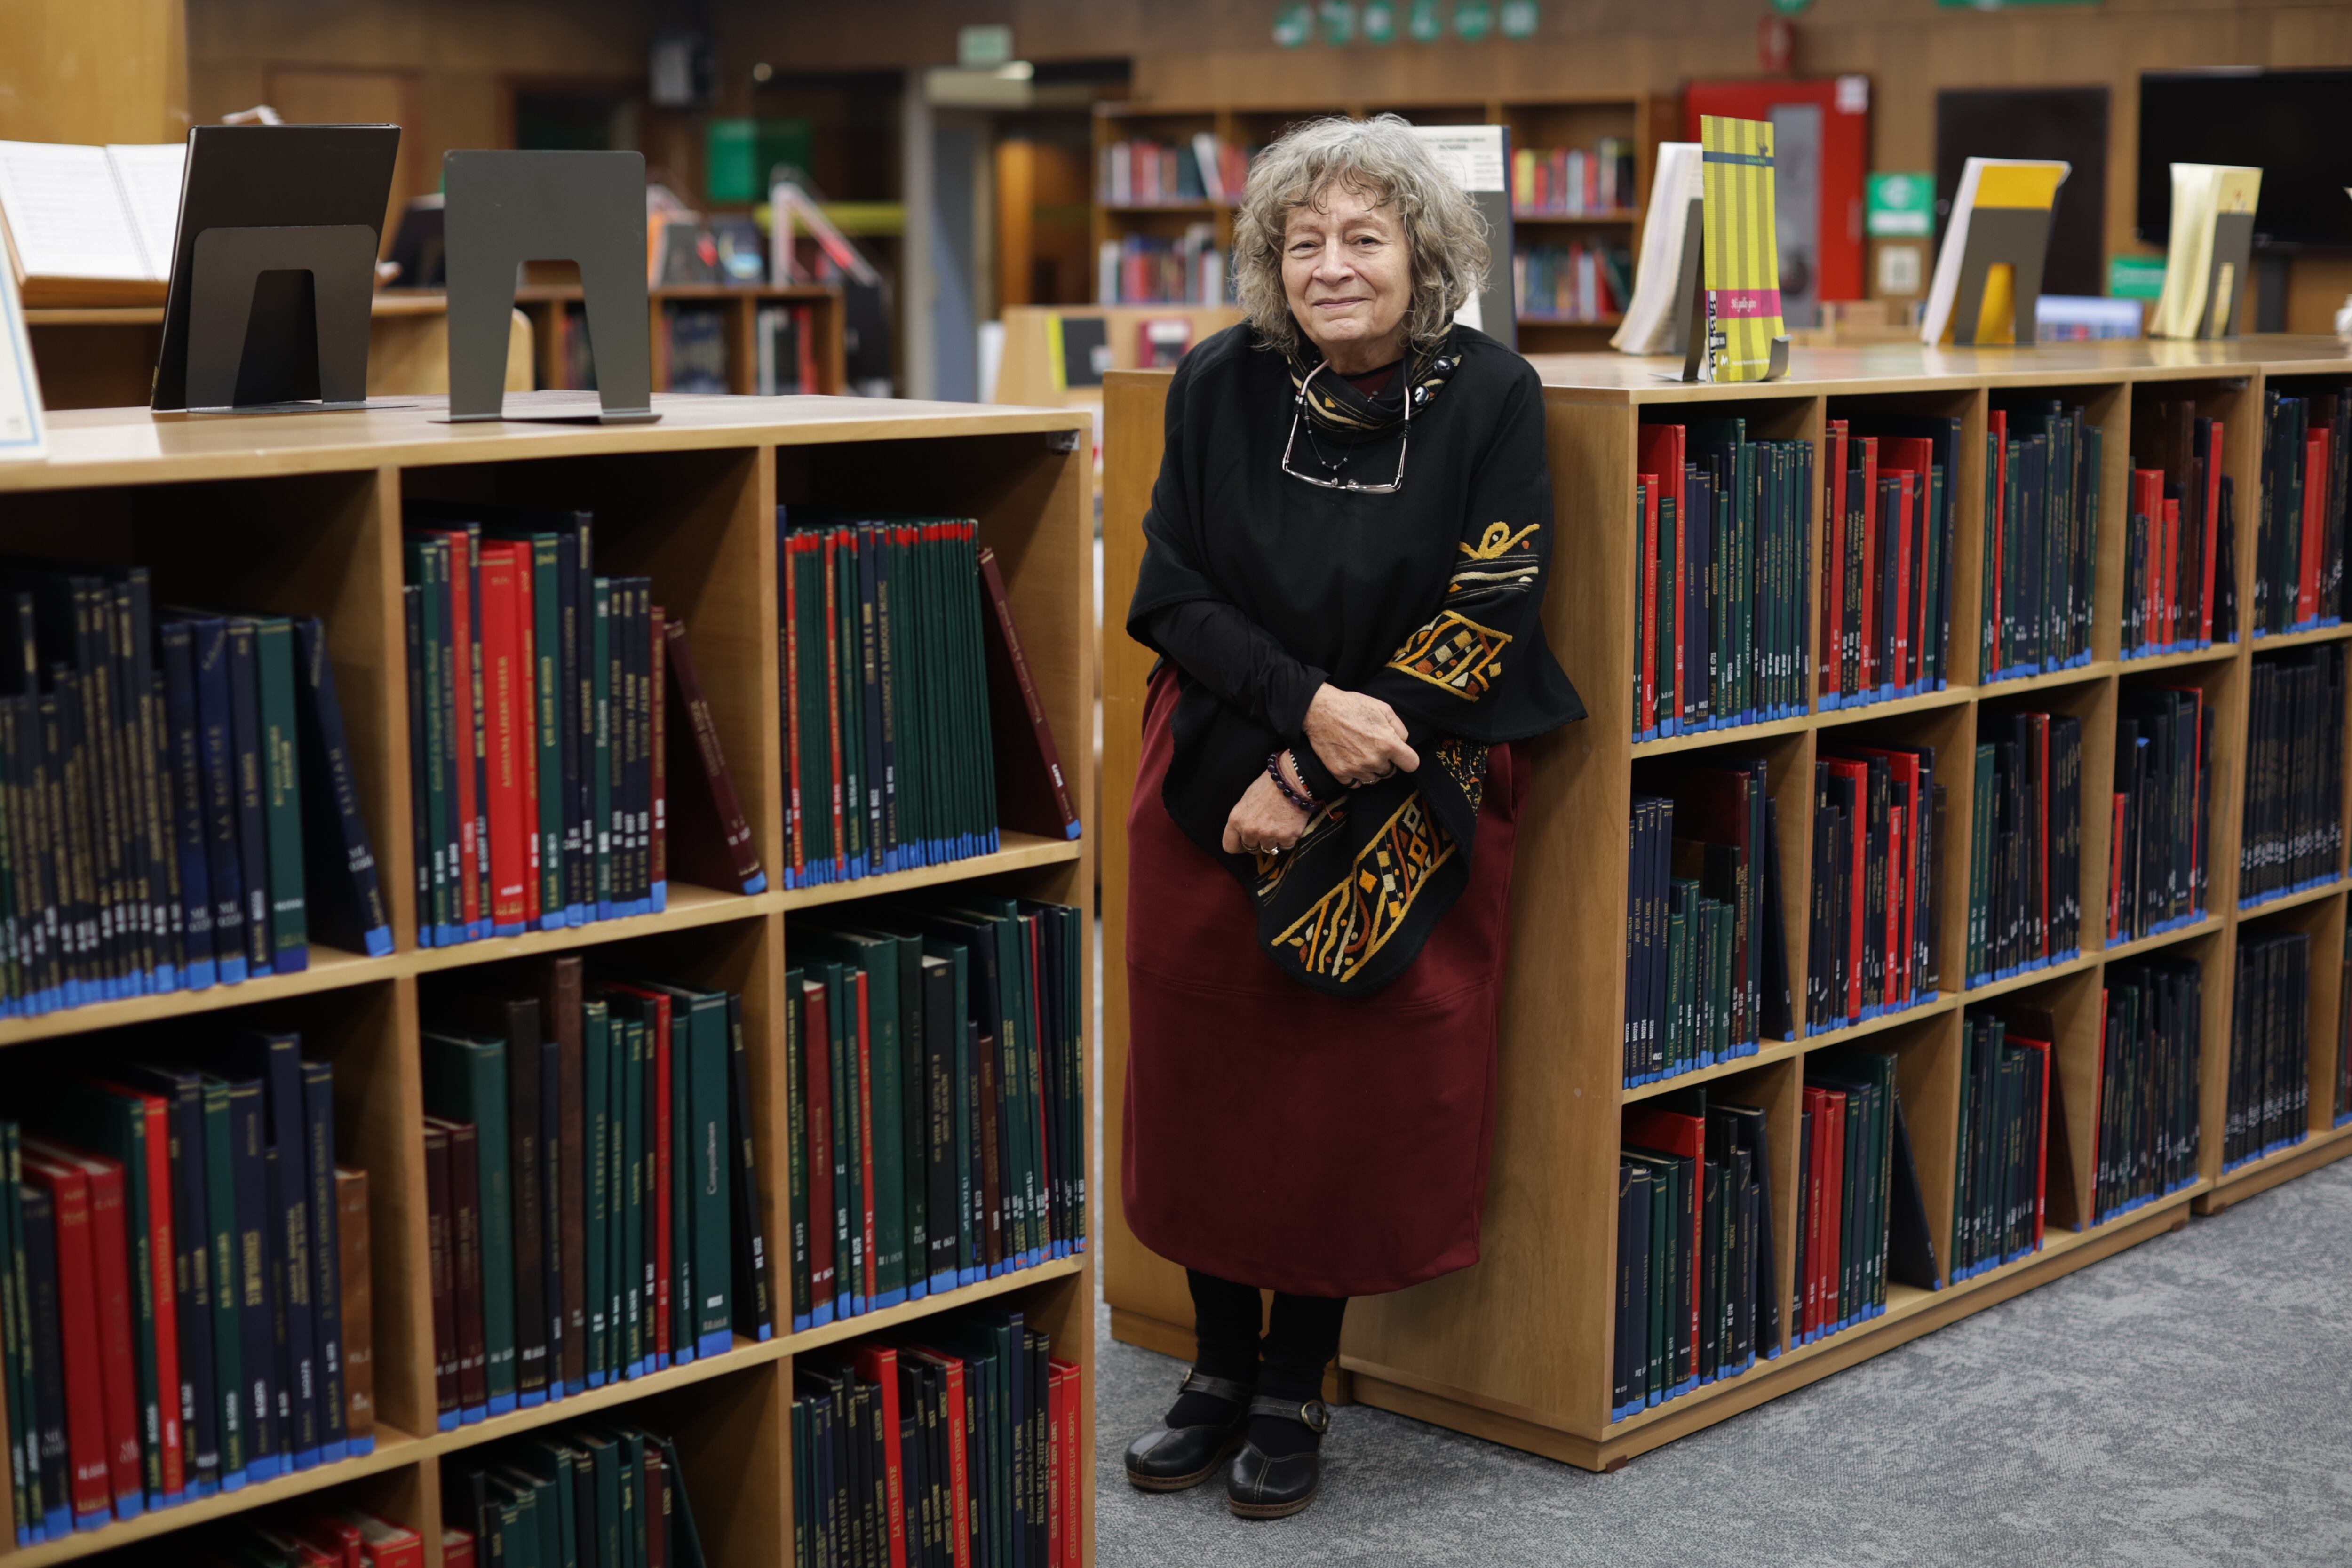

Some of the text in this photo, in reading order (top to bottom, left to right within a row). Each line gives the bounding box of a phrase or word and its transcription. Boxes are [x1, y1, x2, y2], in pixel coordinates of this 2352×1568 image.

[877, 580, 888, 612] MUSIC
[889, 1465, 898, 1498] BREVE
[838, 1488, 849, 1552] MANOLITO
[891, 1499, 899, 1523] VIDA
[958, 1522, 967, 1567] LUSTIGEN
